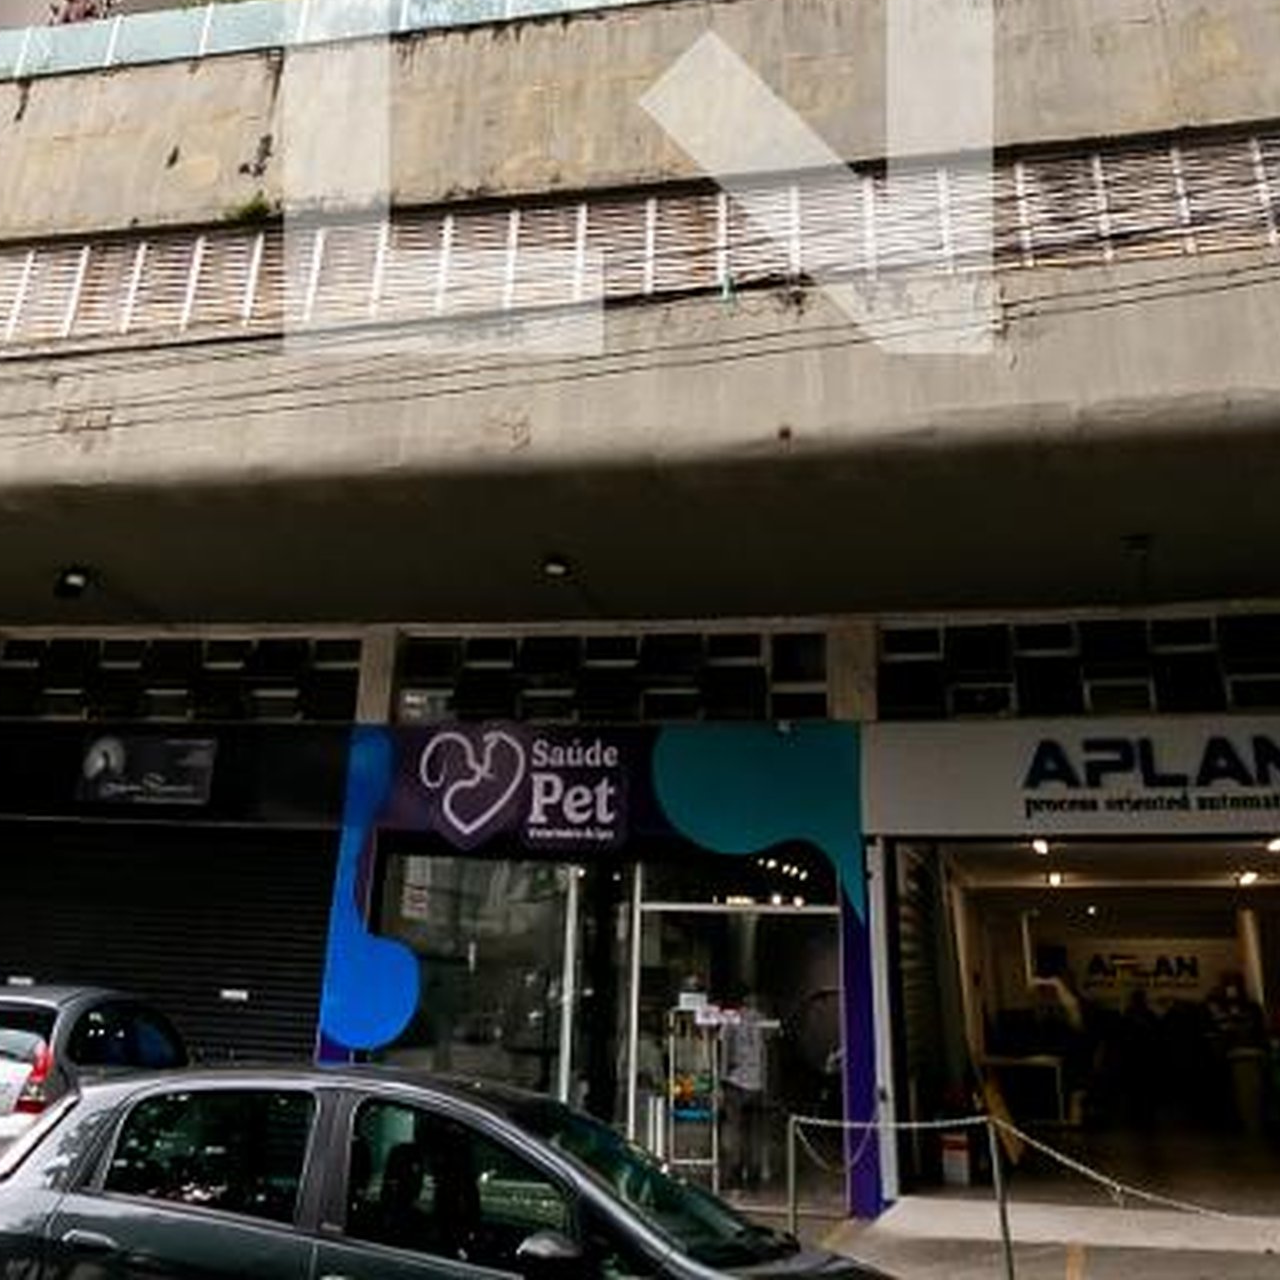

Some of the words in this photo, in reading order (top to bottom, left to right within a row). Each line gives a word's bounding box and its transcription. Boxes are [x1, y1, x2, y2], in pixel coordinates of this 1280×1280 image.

[531, 737, 619, 768] Saúde
[528, 773, 616, 824] Pet
[1025, 797, 1099, 819] process
[1104, 789, 1191, 813] oriented
